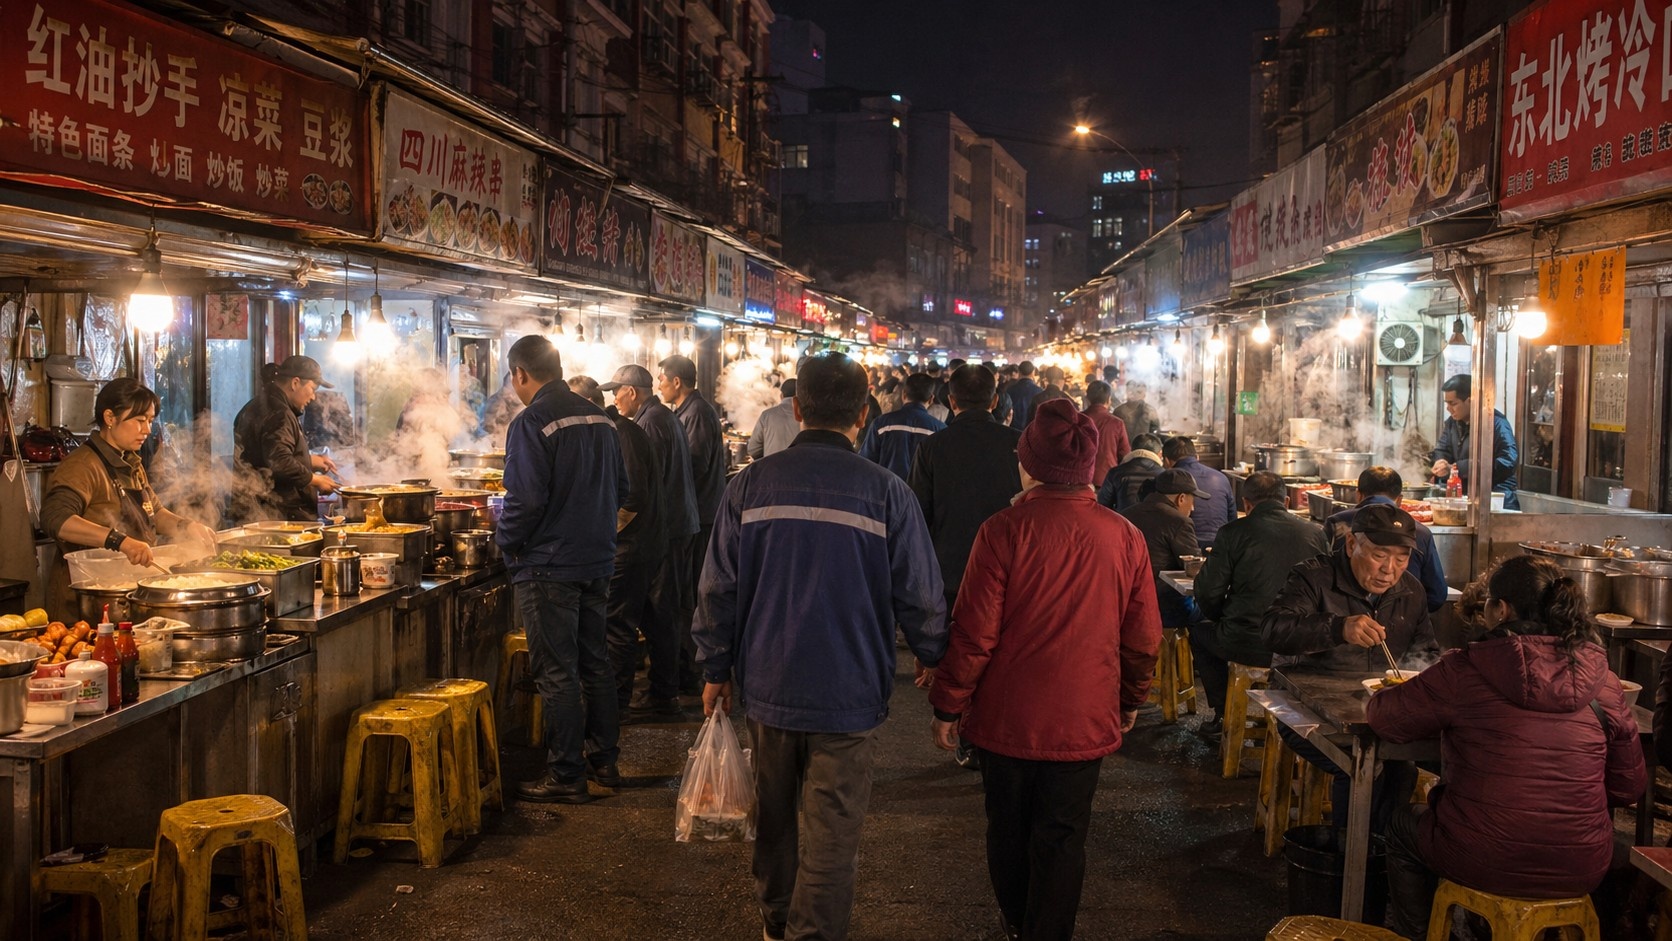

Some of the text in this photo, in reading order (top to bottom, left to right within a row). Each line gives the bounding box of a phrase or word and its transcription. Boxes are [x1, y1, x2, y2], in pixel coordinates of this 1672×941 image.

[25, 4, 354, 168] 红油抄手 凉菜 豆浆
[1508, 0, 1672, 158] 东北烤冷
[28, 108, 134, 171] 特色面条
[206, 151, 245, 193] 炒饭
[255, 163, 289, 201] 炒菜
[399, 128, 502, 204] 四川麻辣串
